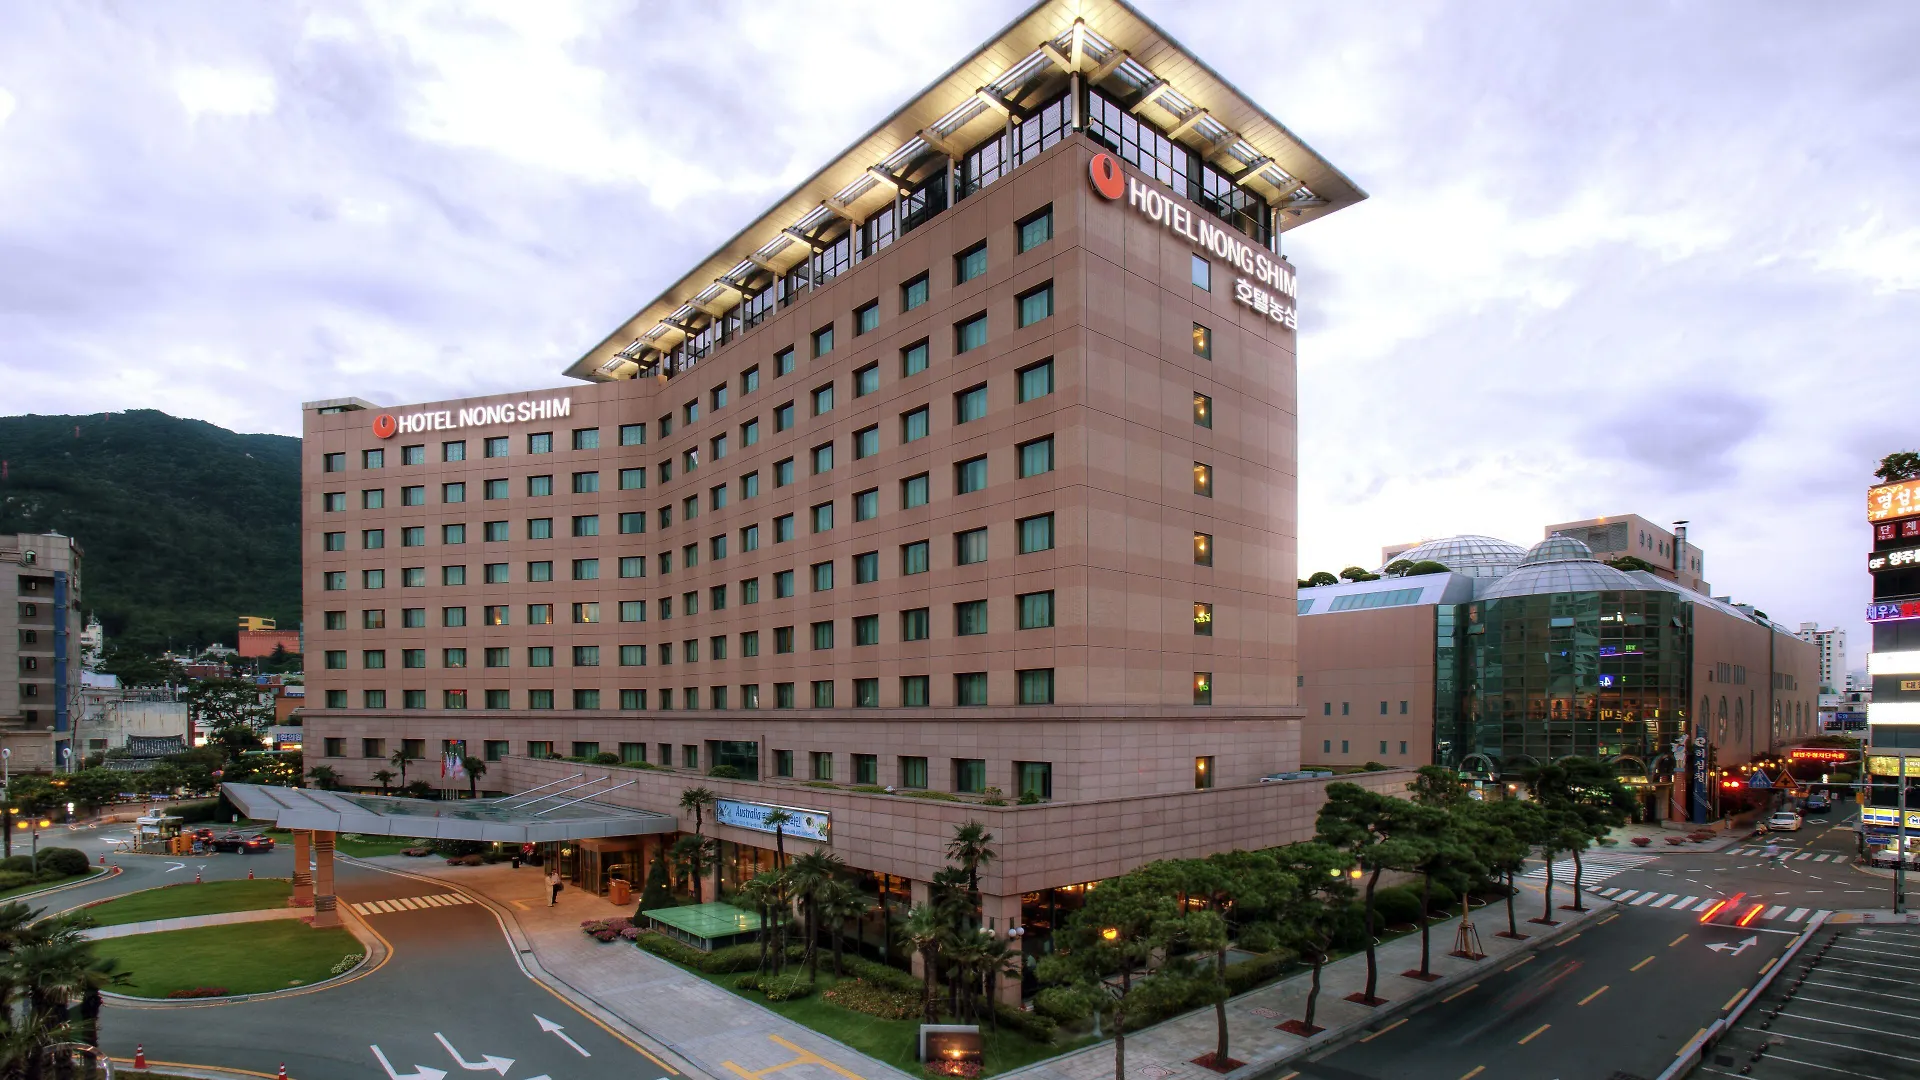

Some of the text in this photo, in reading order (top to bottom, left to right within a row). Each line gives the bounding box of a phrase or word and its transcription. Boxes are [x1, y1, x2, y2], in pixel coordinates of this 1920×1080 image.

[1129, 177, 1198, 242] HOTEL
[398, 411, 457, 434] HOTEL
[735, 805, 761, 820] Australia
